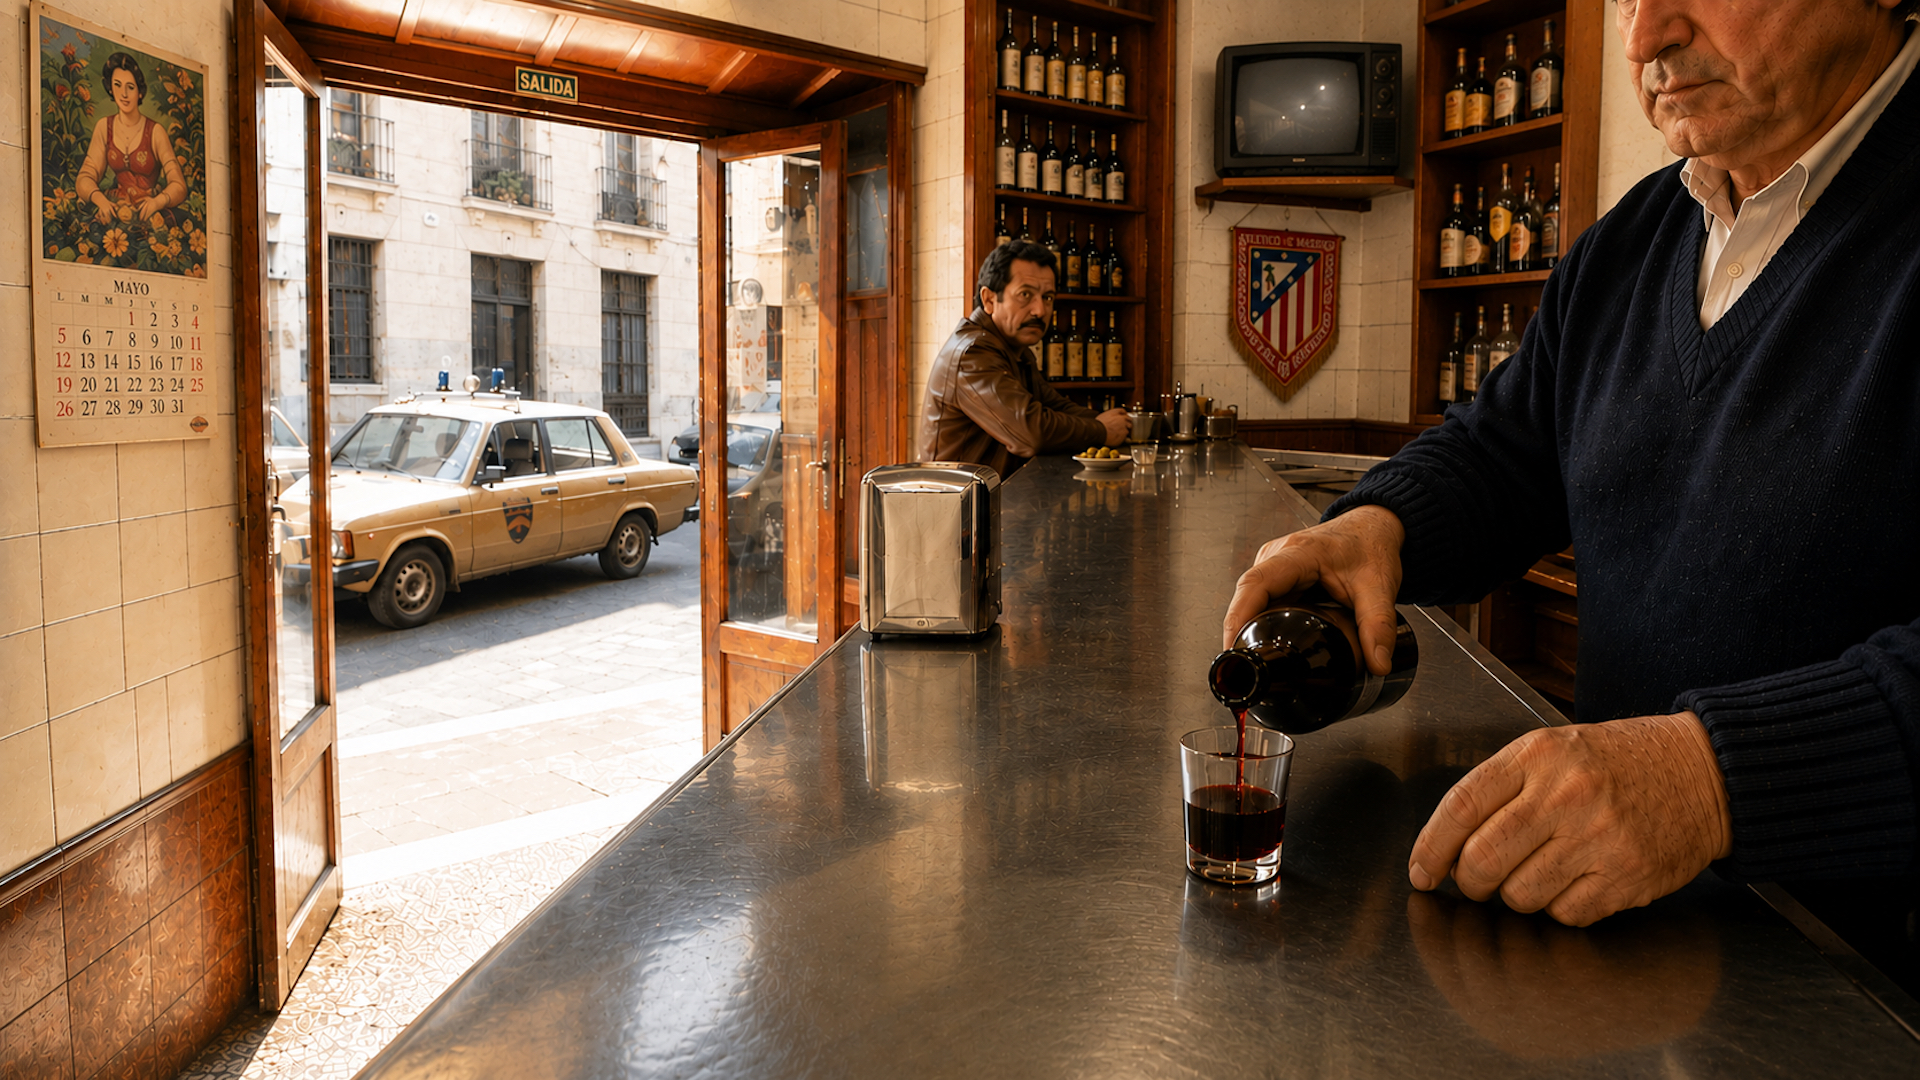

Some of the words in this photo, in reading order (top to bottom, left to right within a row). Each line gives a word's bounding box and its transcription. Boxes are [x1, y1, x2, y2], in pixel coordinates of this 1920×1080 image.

[520, 73, 573, 97] SALIDA
[114, 280, 149, 296] MAYO
[57, 292, 64, 301] L
[81, 294, 89, 303] M
[104, 296, 113, 305] M
[129, 311, 134, 326] 1
[150, 313, 157, 327] 2
[172, 314, 179, 328] 3
[191, 316, 199, 329] 4
[58, 328, 66, 344] 5
[82, 329, 91, 345] 6
[106, 331, 114, 346] 7
[128, 332, 136, 347] 8
[151, 334, 158, 348] 9
[170, 336, 182, 350] 10
[191, 337, 201, 350] 11
[56, 352, 71, 368] 12
[81, 353, 95, 369] 13
[104, 354, 119, 370] 14
[128, 355, 141, 370] 15
[150, 356, 163, 370] 16
[171, 357, 183, 371] 17
[191, 358, 203, 371] 18
[56, 377, 72, 393] 19
[80, 377, 97, 393] 20
[105, 377, 119, 392] 21
[128, 378, 142, 392] 22
[149, 378, 164, 392] 23
[170, 378, 184, 392] 24
[191, 379, 204, 392] 25
[56, 401, 74, 417] 26
[81, 401, 97, 416] 27
[105, 400, 121, 415] 28
[128, 400, 143, 414] 29
[150, 399, 165, 413] 30
[172, 399, 184, 413] 31
